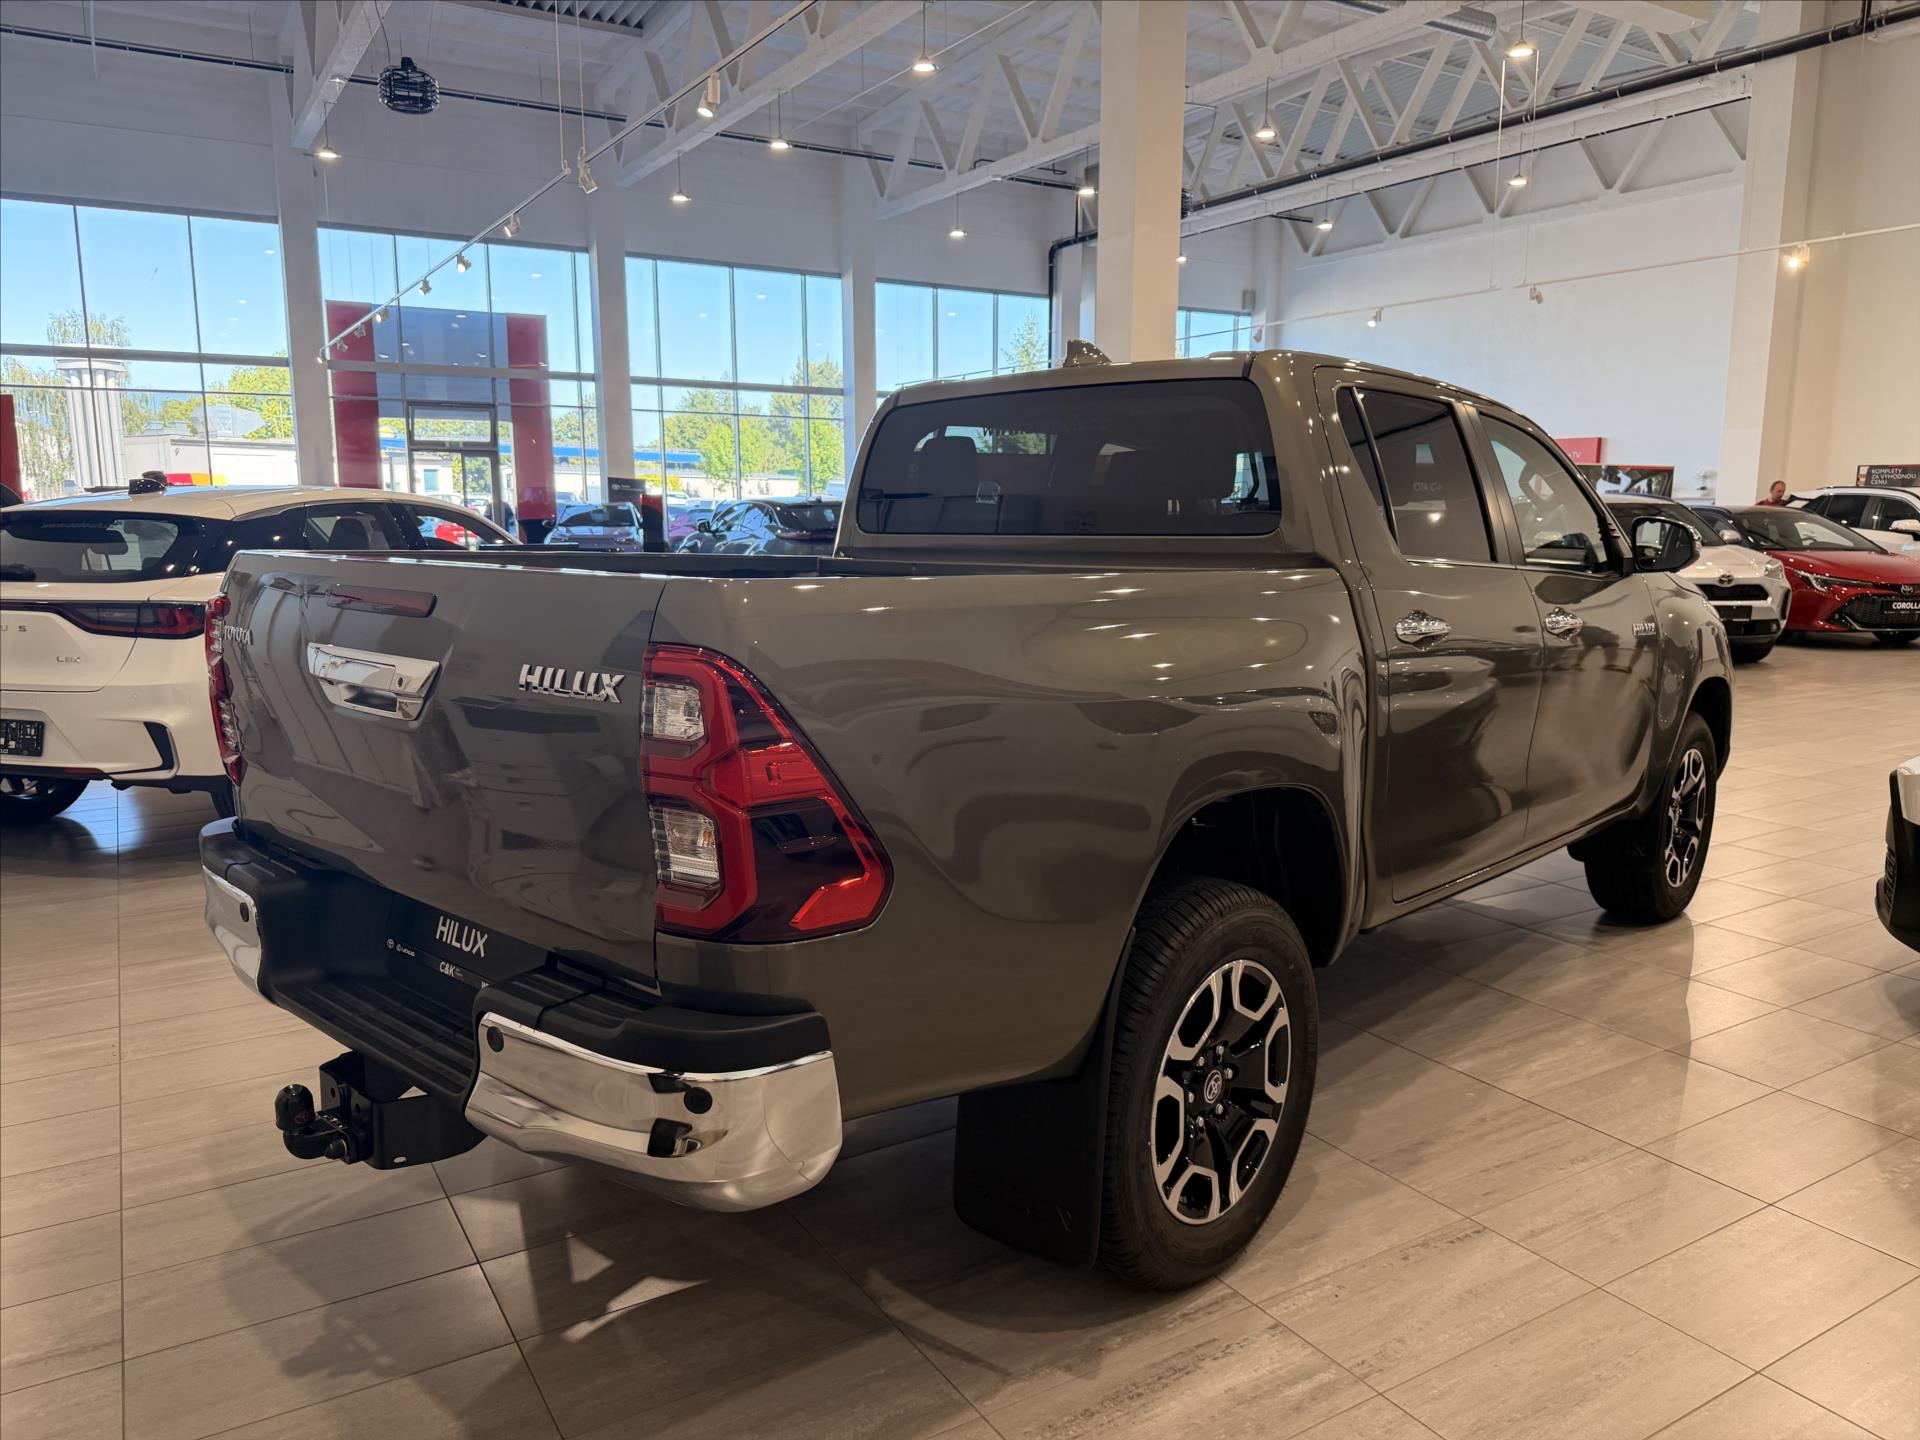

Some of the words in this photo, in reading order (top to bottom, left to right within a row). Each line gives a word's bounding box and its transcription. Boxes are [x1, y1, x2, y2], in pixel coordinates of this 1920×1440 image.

[224, 625, 251, 645] TOYOTA
[519, 664, 625, 703] HILUX
[436, 915, 488, 957] HILUX
[440, 961, 455, 977] C&K
